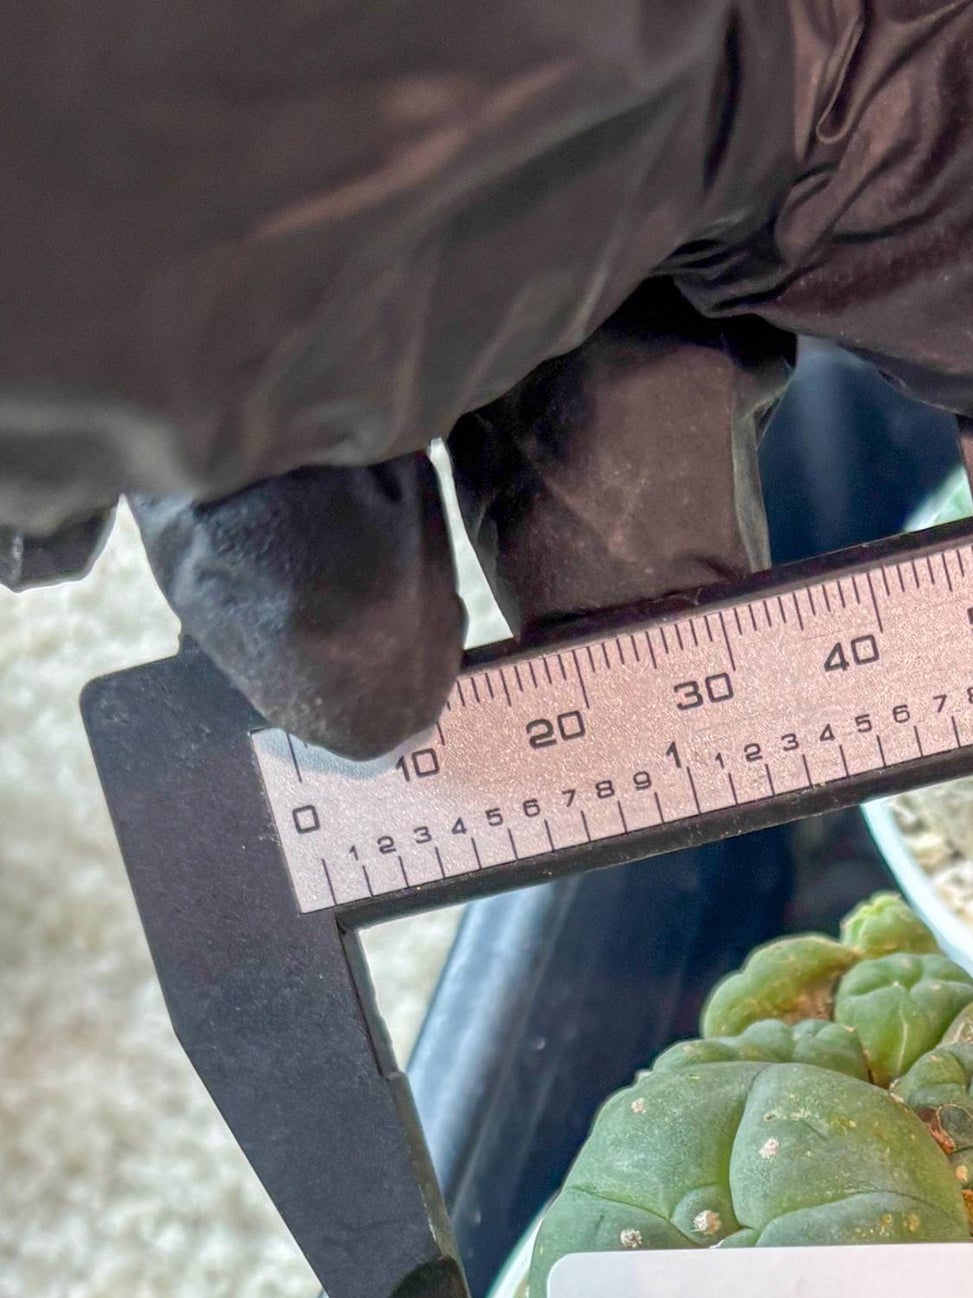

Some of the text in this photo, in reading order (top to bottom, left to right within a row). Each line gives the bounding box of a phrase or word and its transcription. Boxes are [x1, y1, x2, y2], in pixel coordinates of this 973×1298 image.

[291, 804, 321, 835] 0
[376, 835, 397, 855] 2
[413, 825, 433, 845] 3
[451, 816, 468, 835] 4
[484, 807, 504, 827] 5
[522, 797, 541, 818] 6
[561, 788, 577, 808] 7
[594, 779, 616, 800] 8
[632, 770, 653, 791] 9
[665, 740, 682, 769] 1
[743, 742, 764, 763] 2
[780, 732, 800, 752] 3
[819, 723, 836, 742] 4
[854, 713, 873, 734] 5
[891, 703, 911, 724] 6
[932, 693, 948, 714] 7
[395, 748, 441, 783] 10
[525, 709, 586, 750] 20
[673, 671, 735, 711] 30
[823, 633, 880, 673] 40
